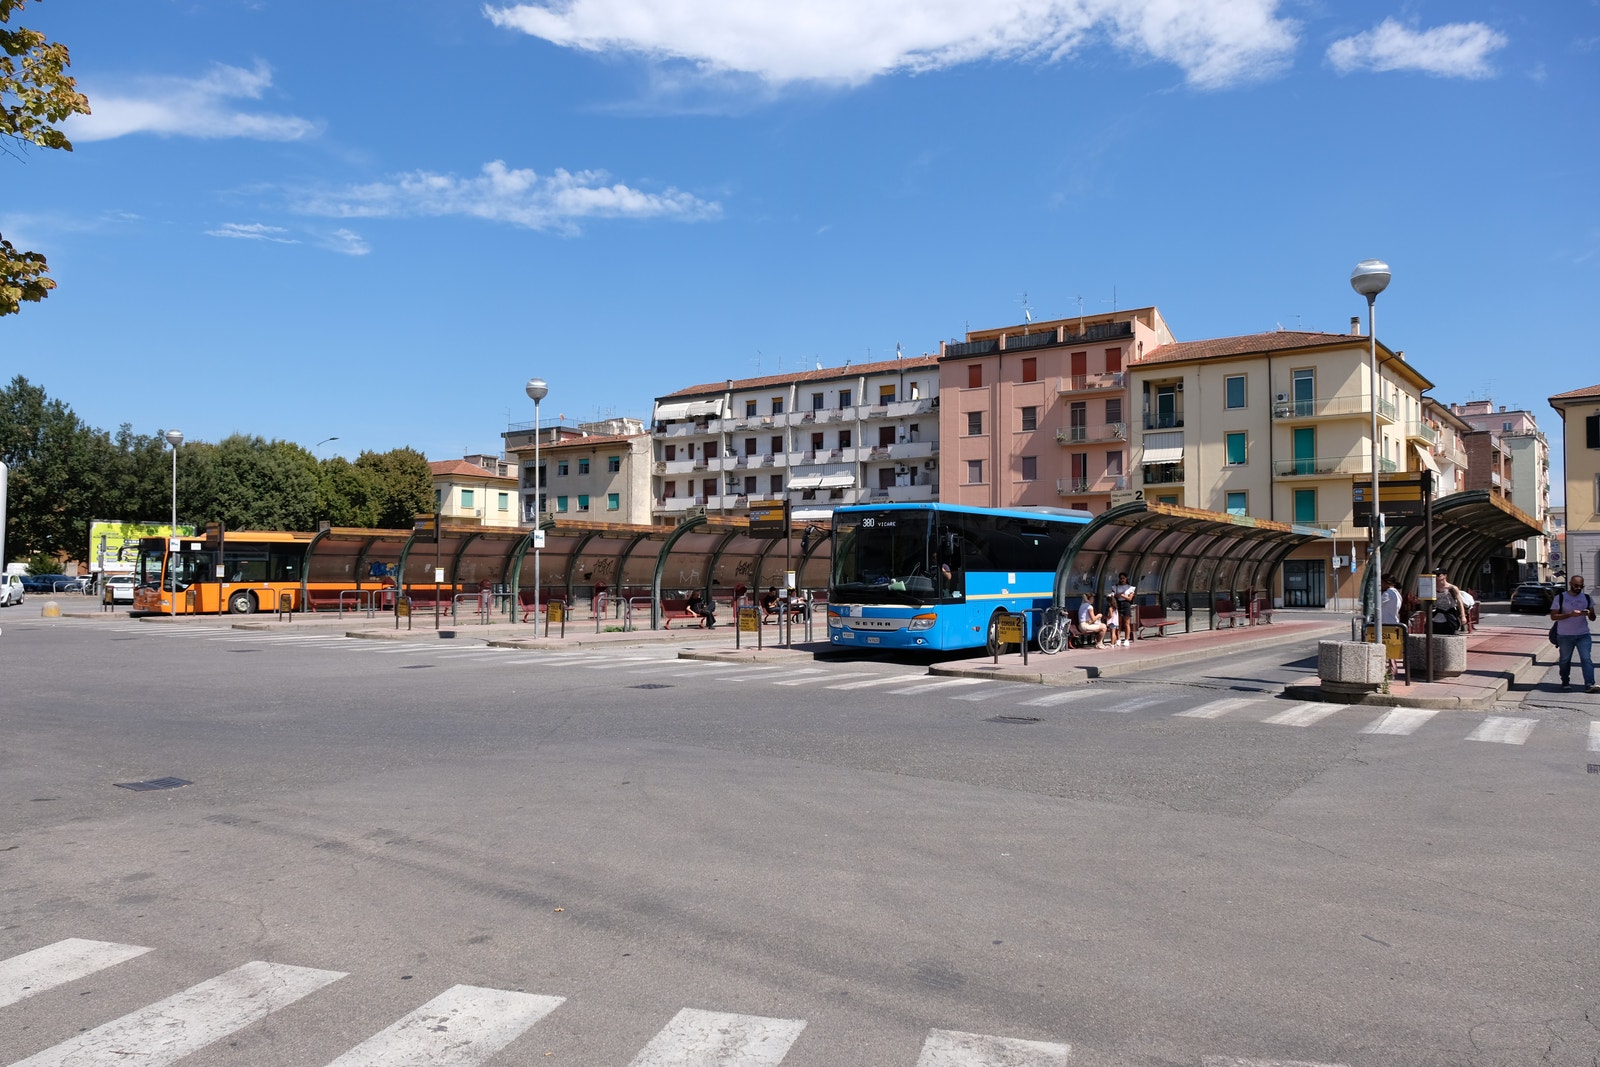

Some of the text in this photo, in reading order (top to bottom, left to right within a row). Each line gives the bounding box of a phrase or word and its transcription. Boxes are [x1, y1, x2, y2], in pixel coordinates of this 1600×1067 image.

[1135, 490, 1143, 500] 2
[549, 512, 554, 520] 5
[862, 518, 875, 527] 380
[1016, 617, 1021, 627] 2
[1370, 628, 1399, 640] CSIA 1
